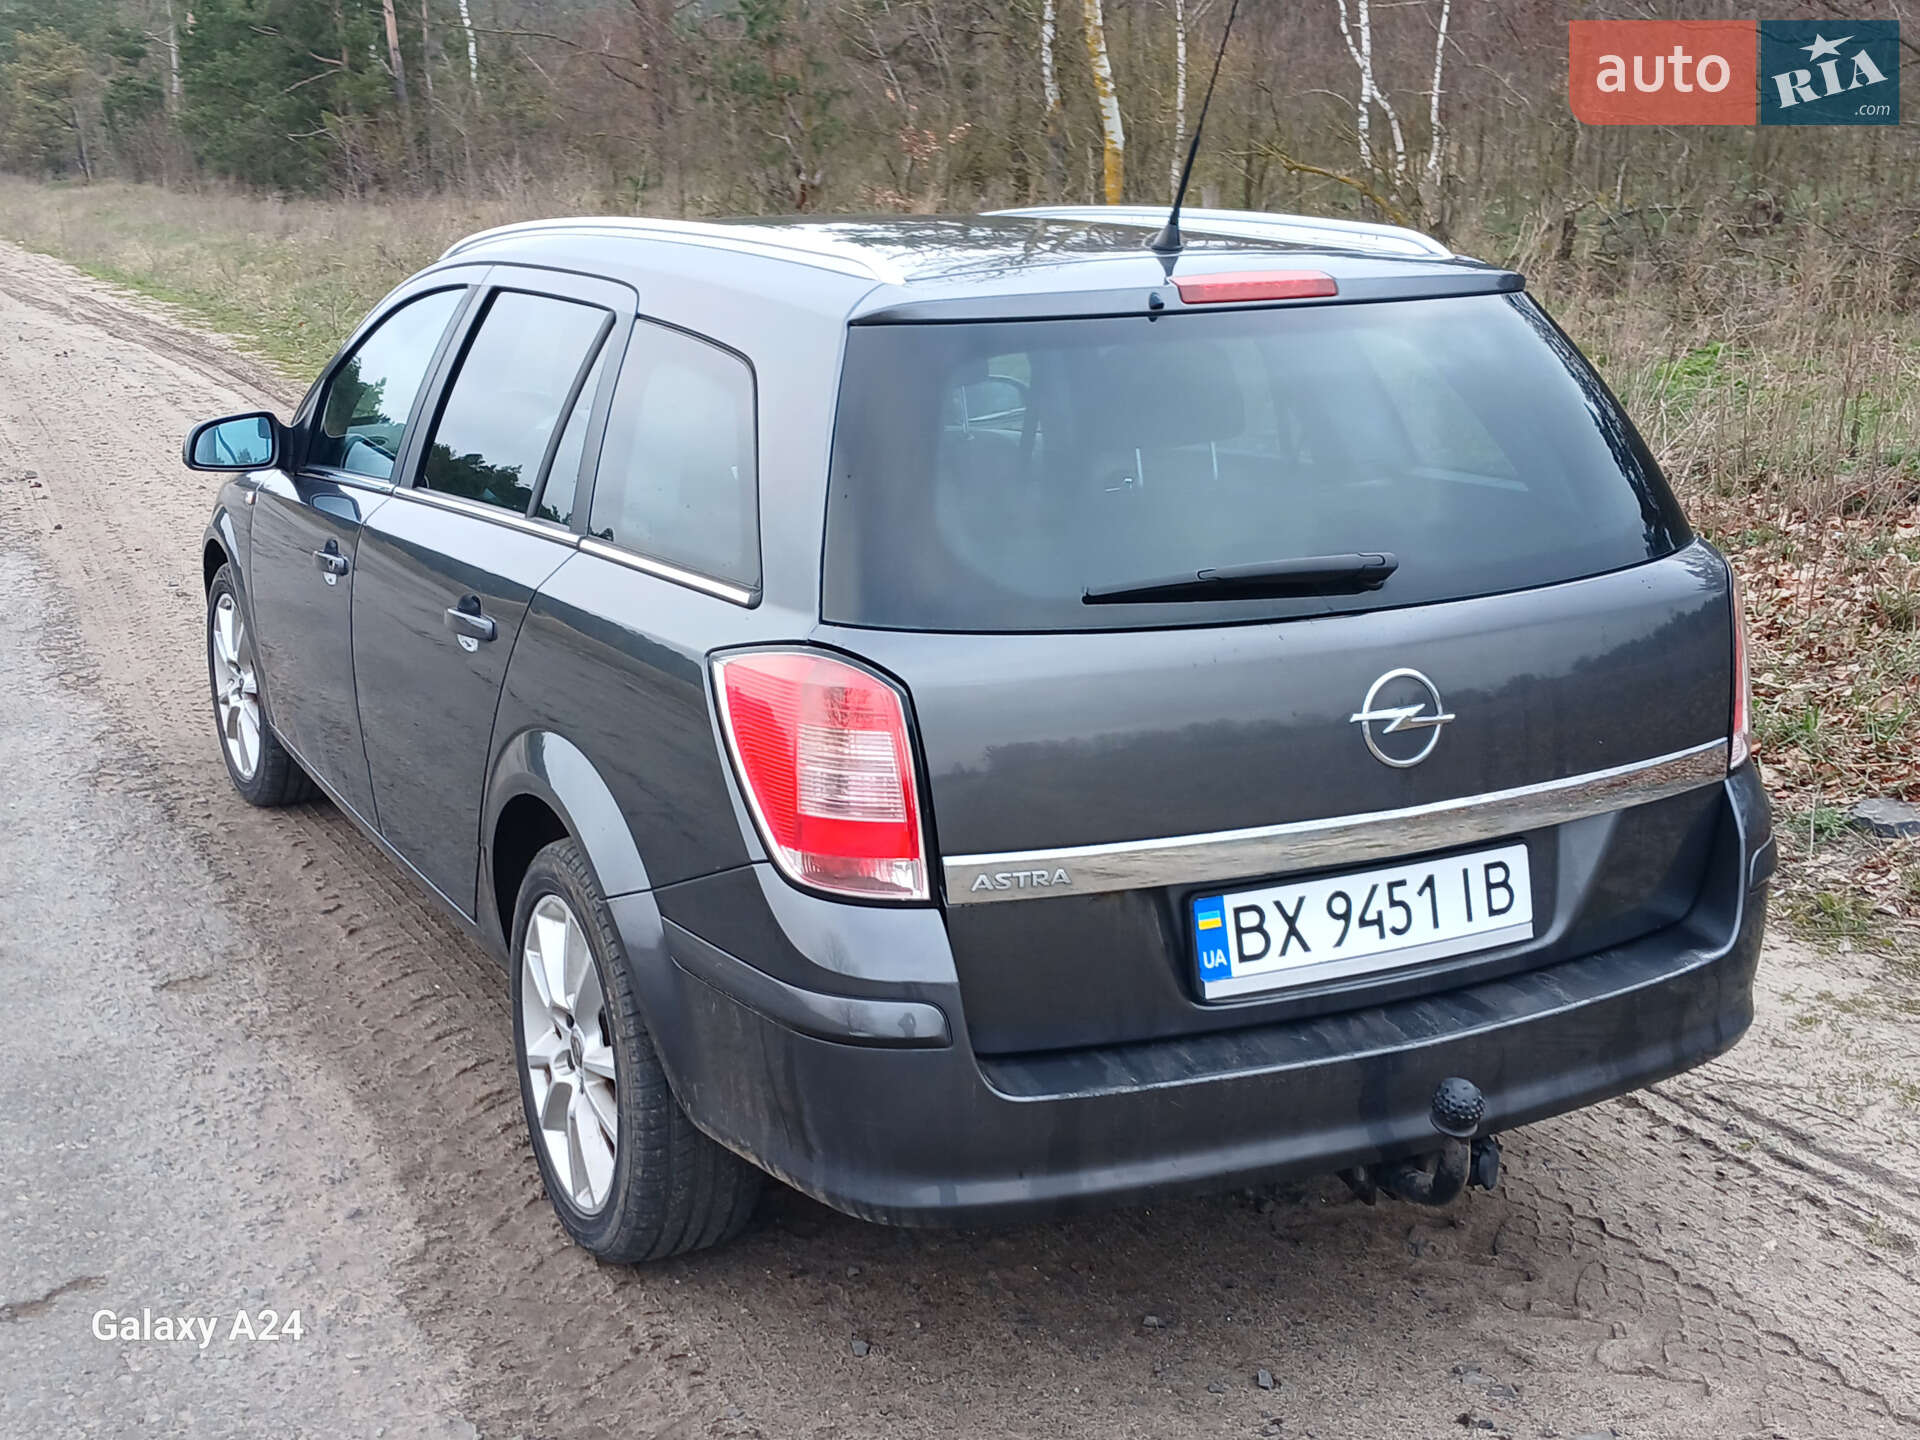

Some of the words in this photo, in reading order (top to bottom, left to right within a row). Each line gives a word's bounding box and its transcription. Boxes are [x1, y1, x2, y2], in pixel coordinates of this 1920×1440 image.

[970, 868, 1072, 892] ASTRA
[1233, 895, 1311, 963] BX
[1326, 873, 1439, 948] 9451
[1462, 860, 1515, 923] IB
[1202, 948, 1228, 969] UA
